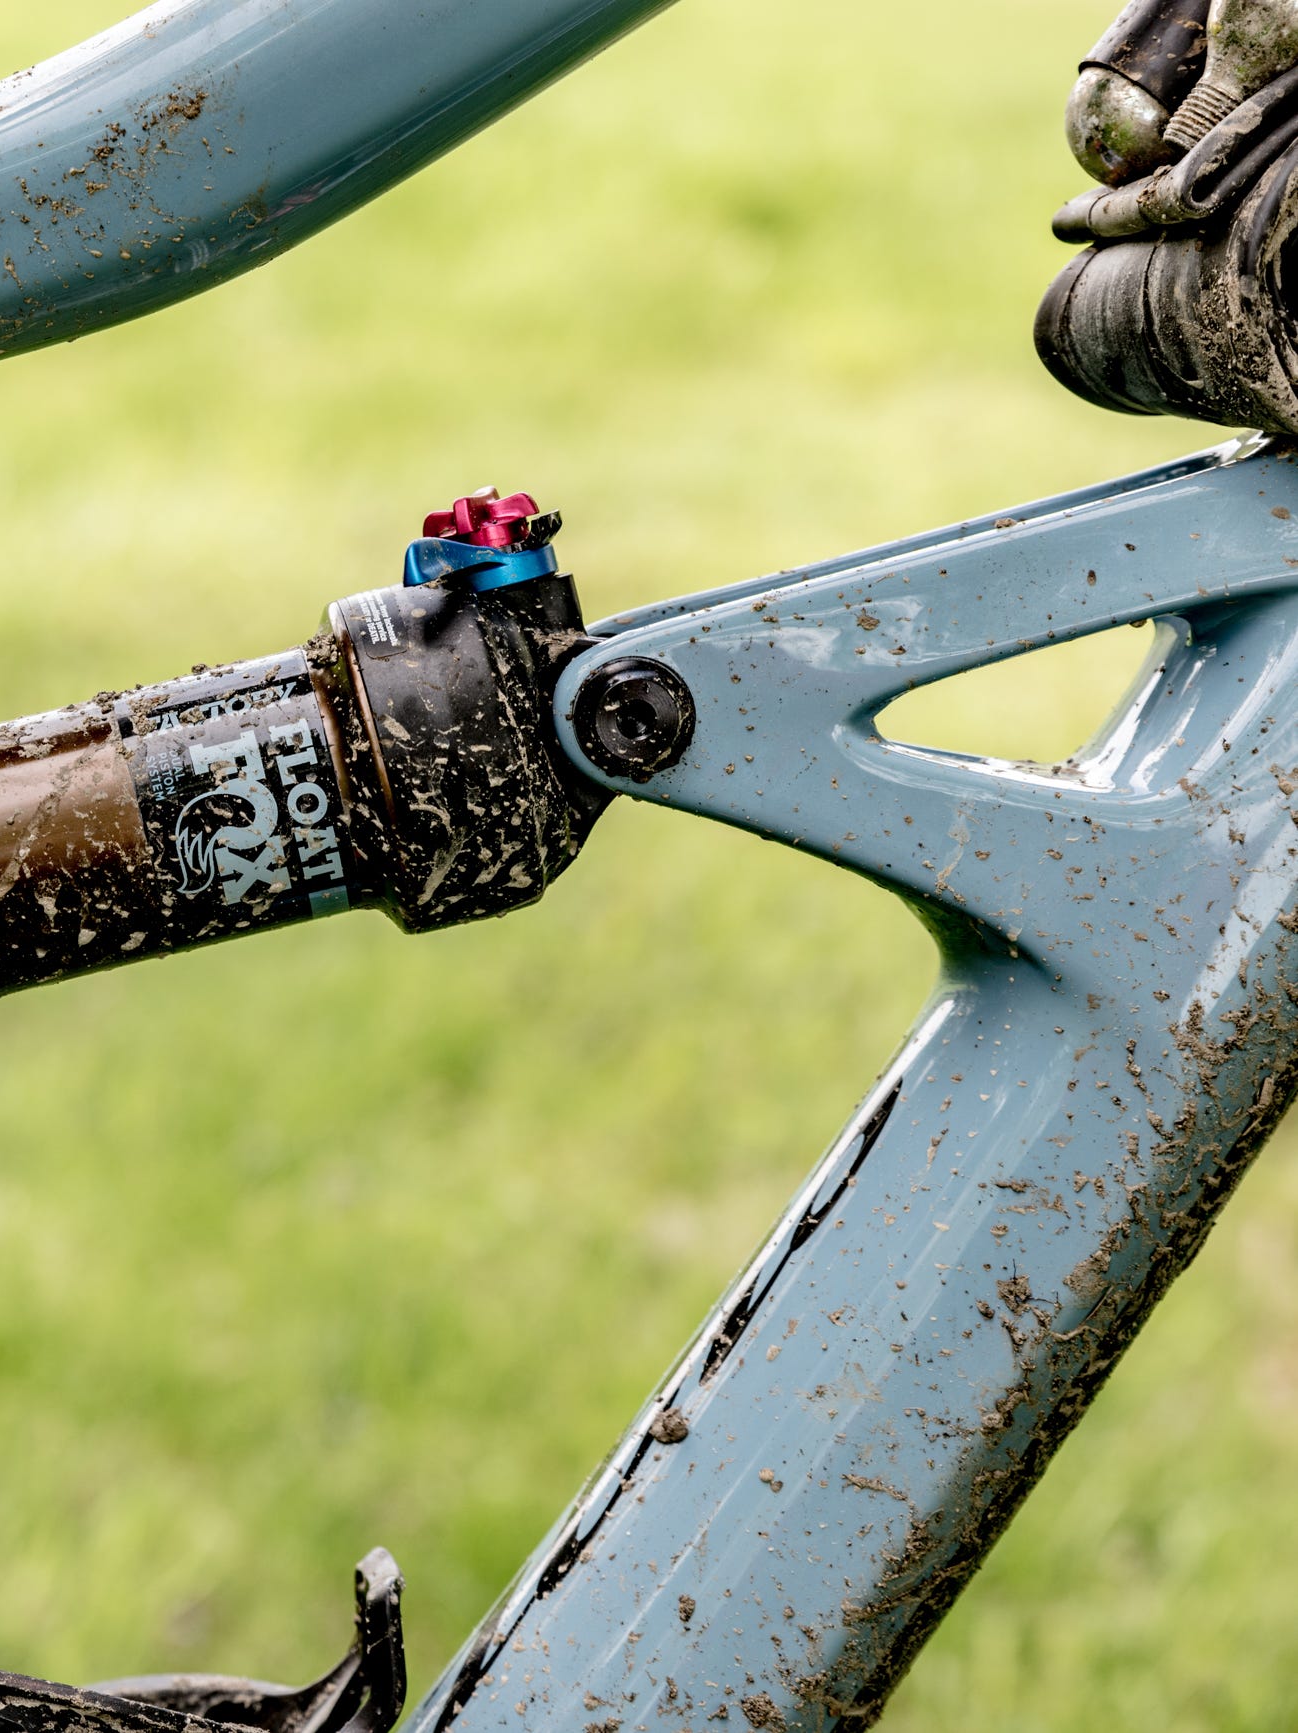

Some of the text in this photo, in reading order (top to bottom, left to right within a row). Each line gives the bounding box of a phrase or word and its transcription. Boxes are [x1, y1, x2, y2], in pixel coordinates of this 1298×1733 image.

[143, 682, 297, 740] ATORY
[146, 755, 166, 802] SYSTEM
[158, 752, 177, 795] PISTON
[169, 750, 186, 782] DUAL
[176, 729, 292, 905] FOX
[269, 718, 345, 880] FLOAT
